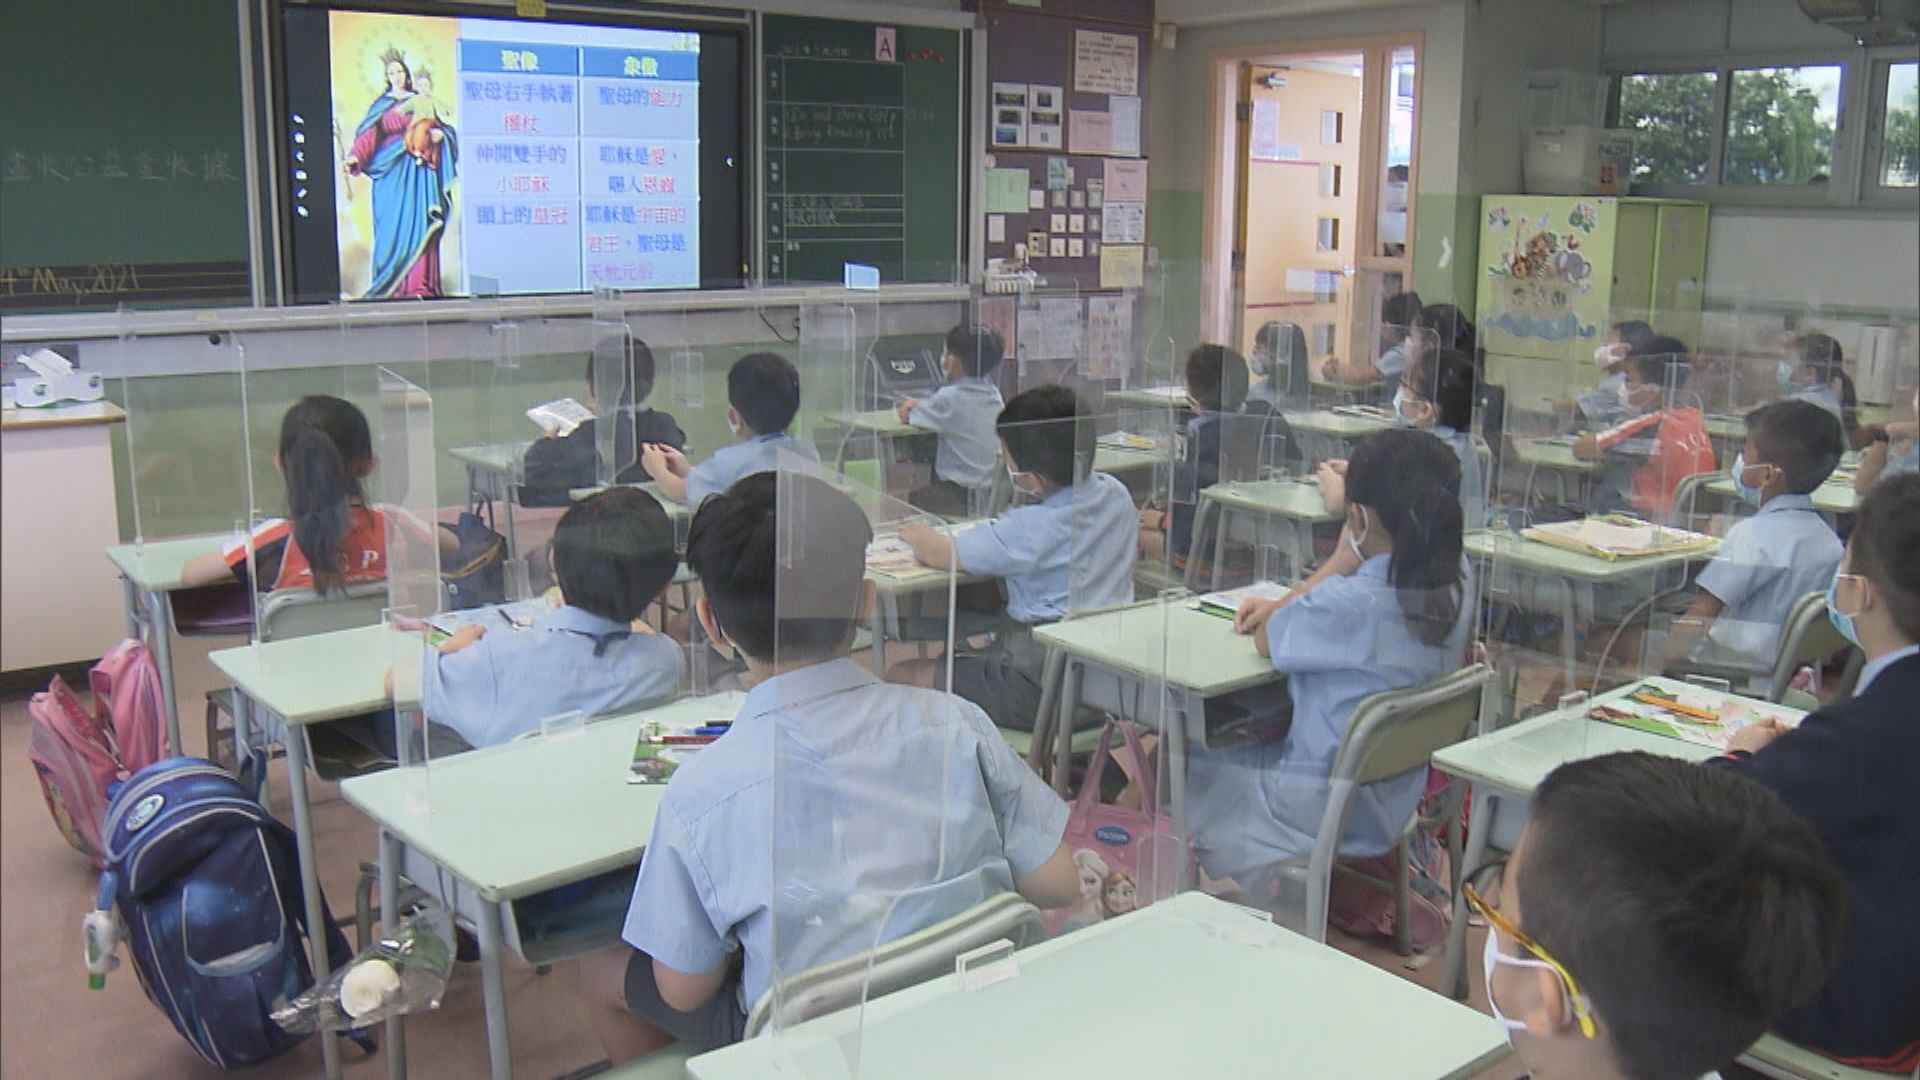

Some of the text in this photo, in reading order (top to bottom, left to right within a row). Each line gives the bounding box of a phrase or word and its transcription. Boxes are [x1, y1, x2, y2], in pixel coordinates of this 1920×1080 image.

[878, 37, 893, 59] A
[599, 86, 683, 108] 聖母的能力
[504, 112, 541, 133] 權杖
[476, 143, 567, 165] 伸開雙手的
[496, 174, 550, 194] 小耶穌
[477, 205, 569, 225] 頭上的皇冠
[585, 205, 687, 225] 耶穌是宇宙的
